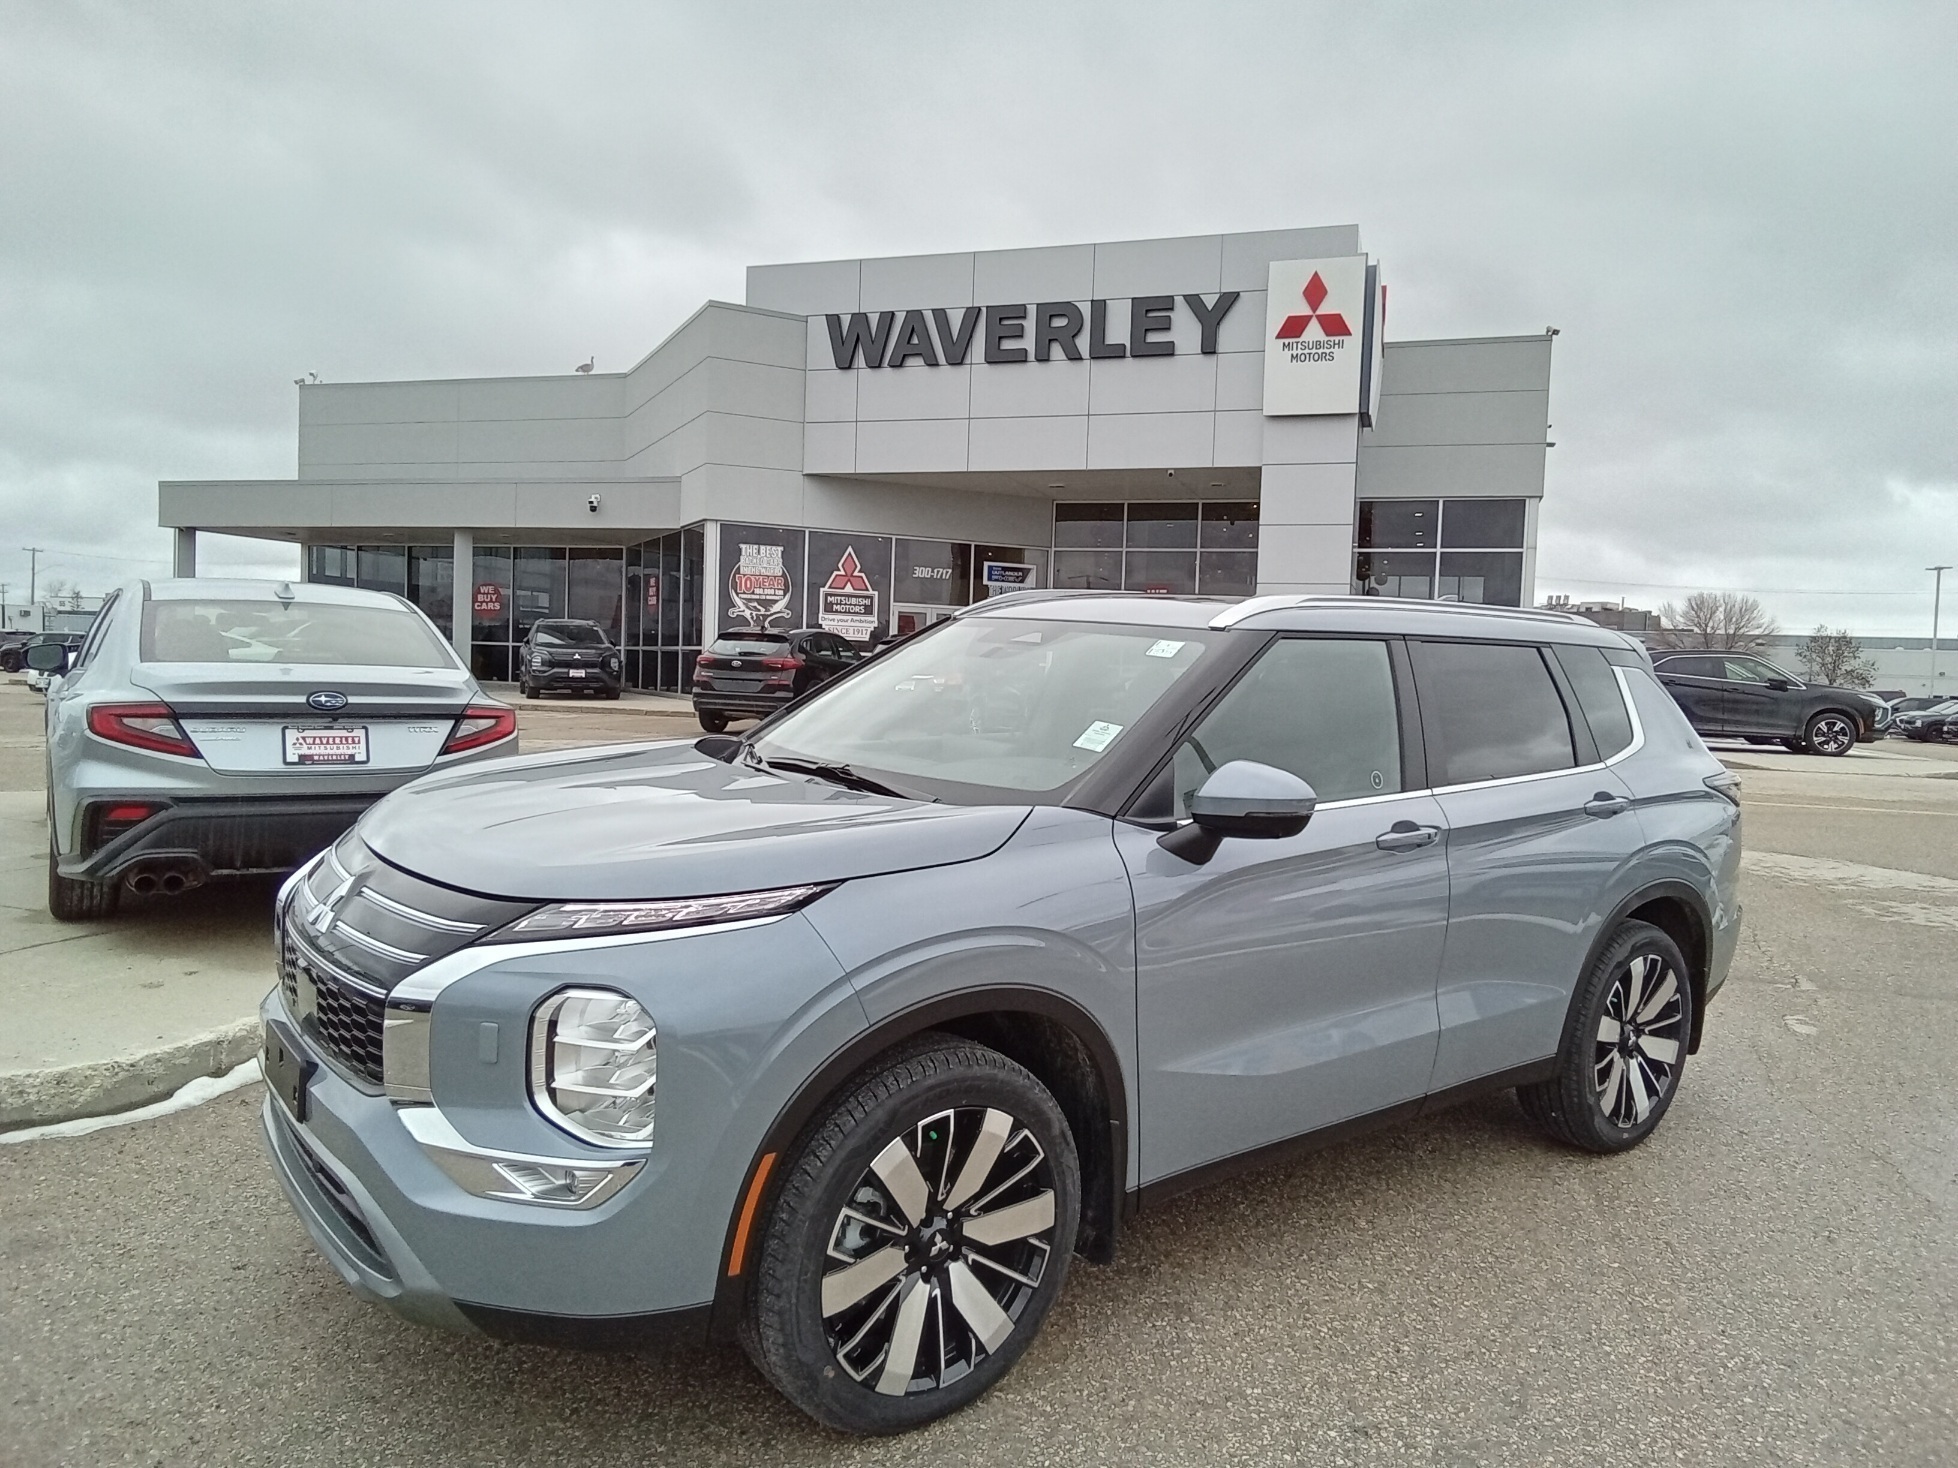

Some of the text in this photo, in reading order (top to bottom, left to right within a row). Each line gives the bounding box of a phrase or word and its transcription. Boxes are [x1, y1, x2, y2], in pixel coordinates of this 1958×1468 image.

[825, 291, 1241, 369] WAVERLEY
[1282, 339, 1345, 352] MITSUBISHI
[1290, 351, 1335, 363] MOTORS
[740, 544, 784, 558] THE BEST
[912, 566, 952, 580] 300-1717
[737, 575, 784, 593] 10 YEAR
[479, 585, 495, 594] WE
[477, 594, 497, 602] BUY
[827, 596, 871, 606] MITSUBISHI
[474, 602, 501, 610] CARS
[832, 604, 865, 613] MOTORS
[850, 617, 876, 625] Ambition
[827, 627, 851, 635] SINCE
